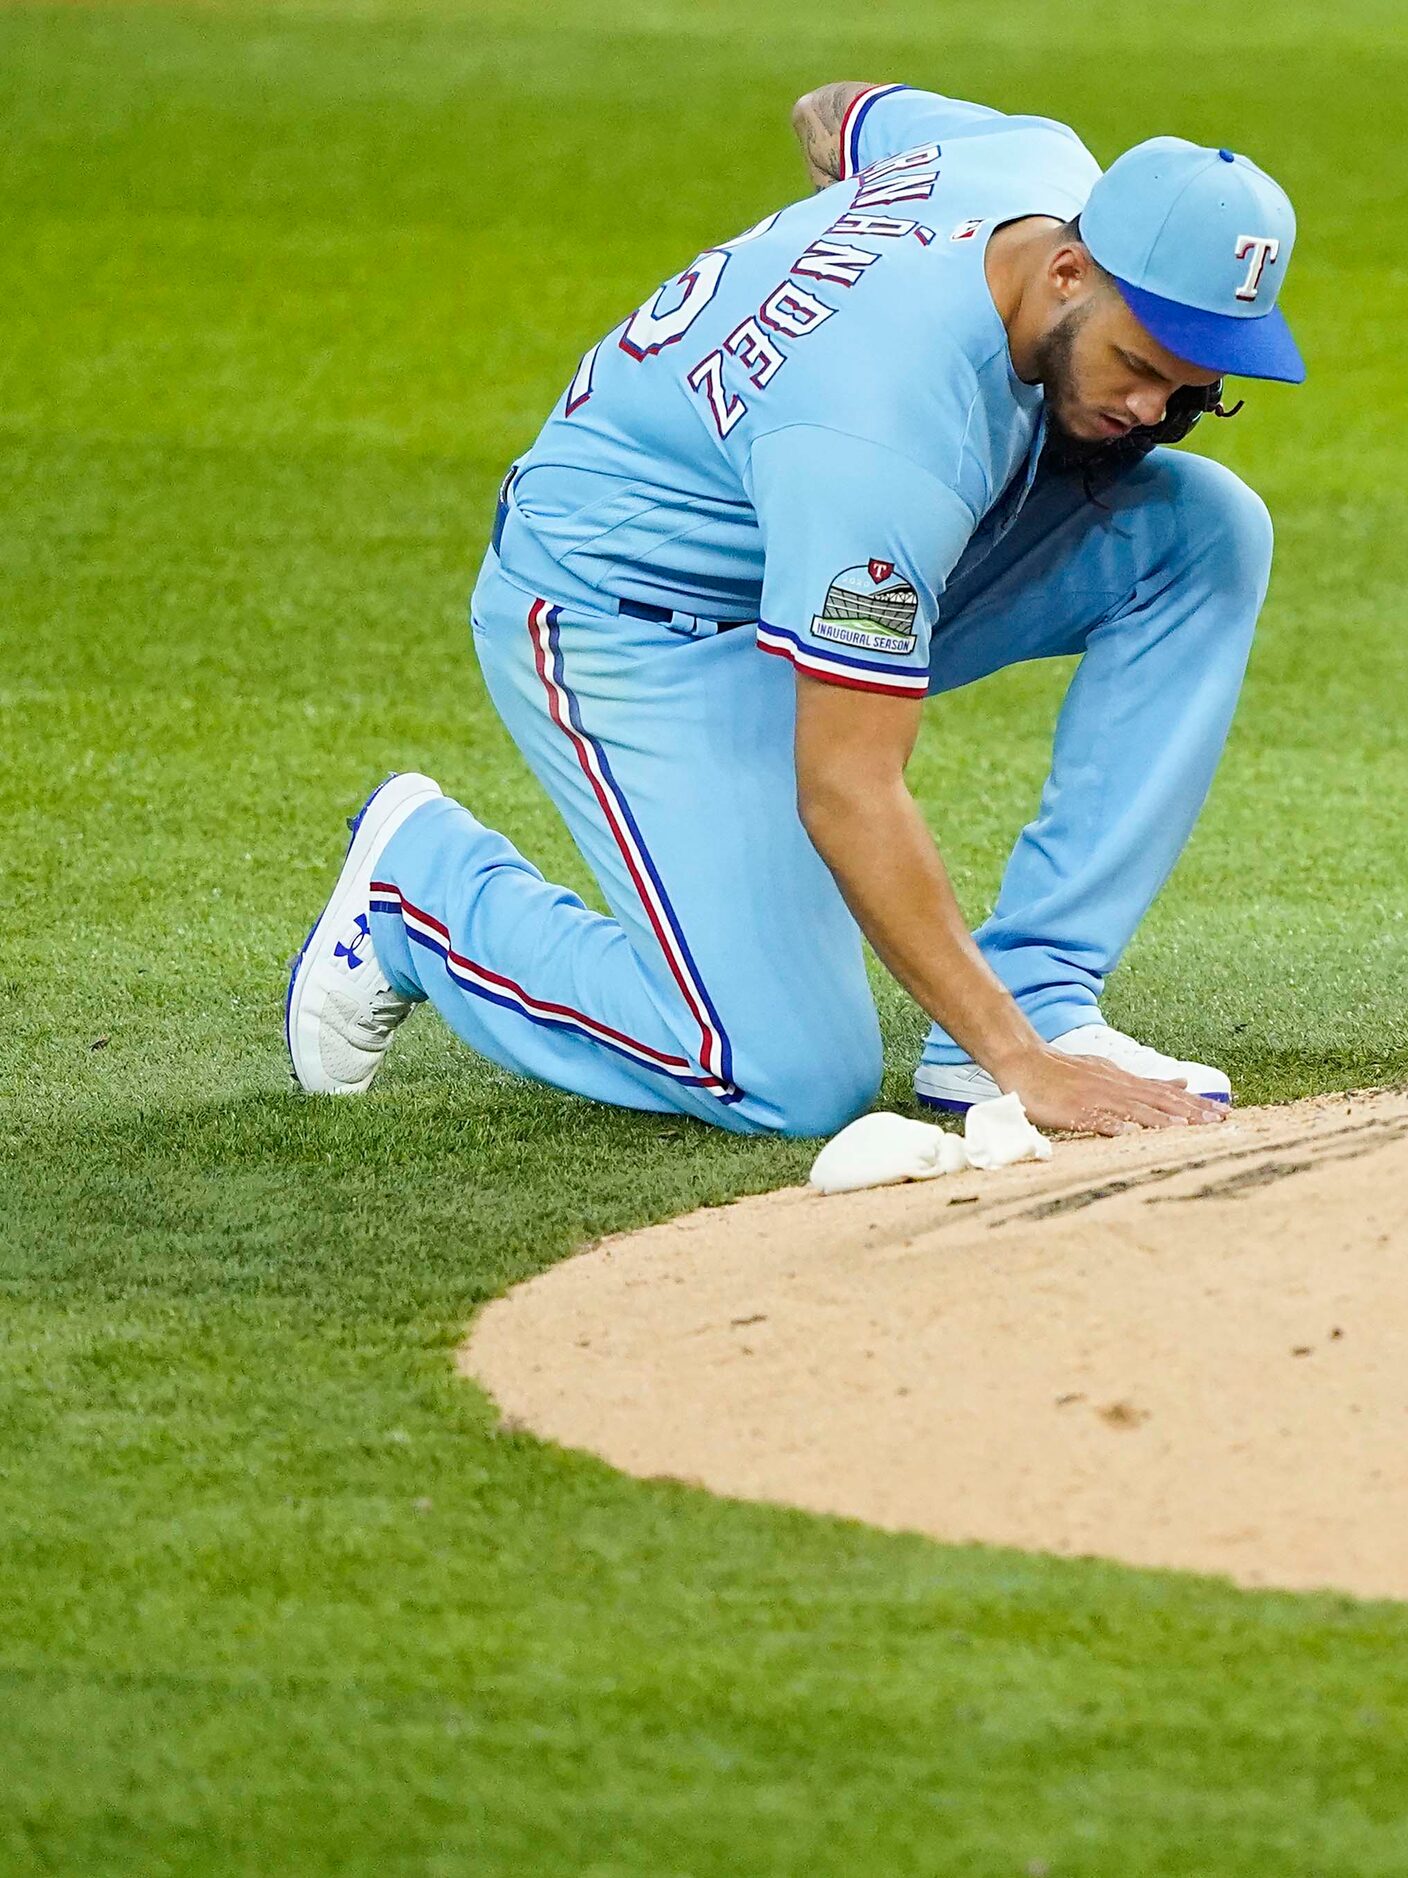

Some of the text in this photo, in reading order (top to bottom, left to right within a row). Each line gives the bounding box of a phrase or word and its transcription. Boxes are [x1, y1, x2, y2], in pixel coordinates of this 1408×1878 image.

[1234, 235, 1280, 302] T
[873, 563, 887, 578] T
[816, 622, 911, 651] INAUGURAL SEASON
